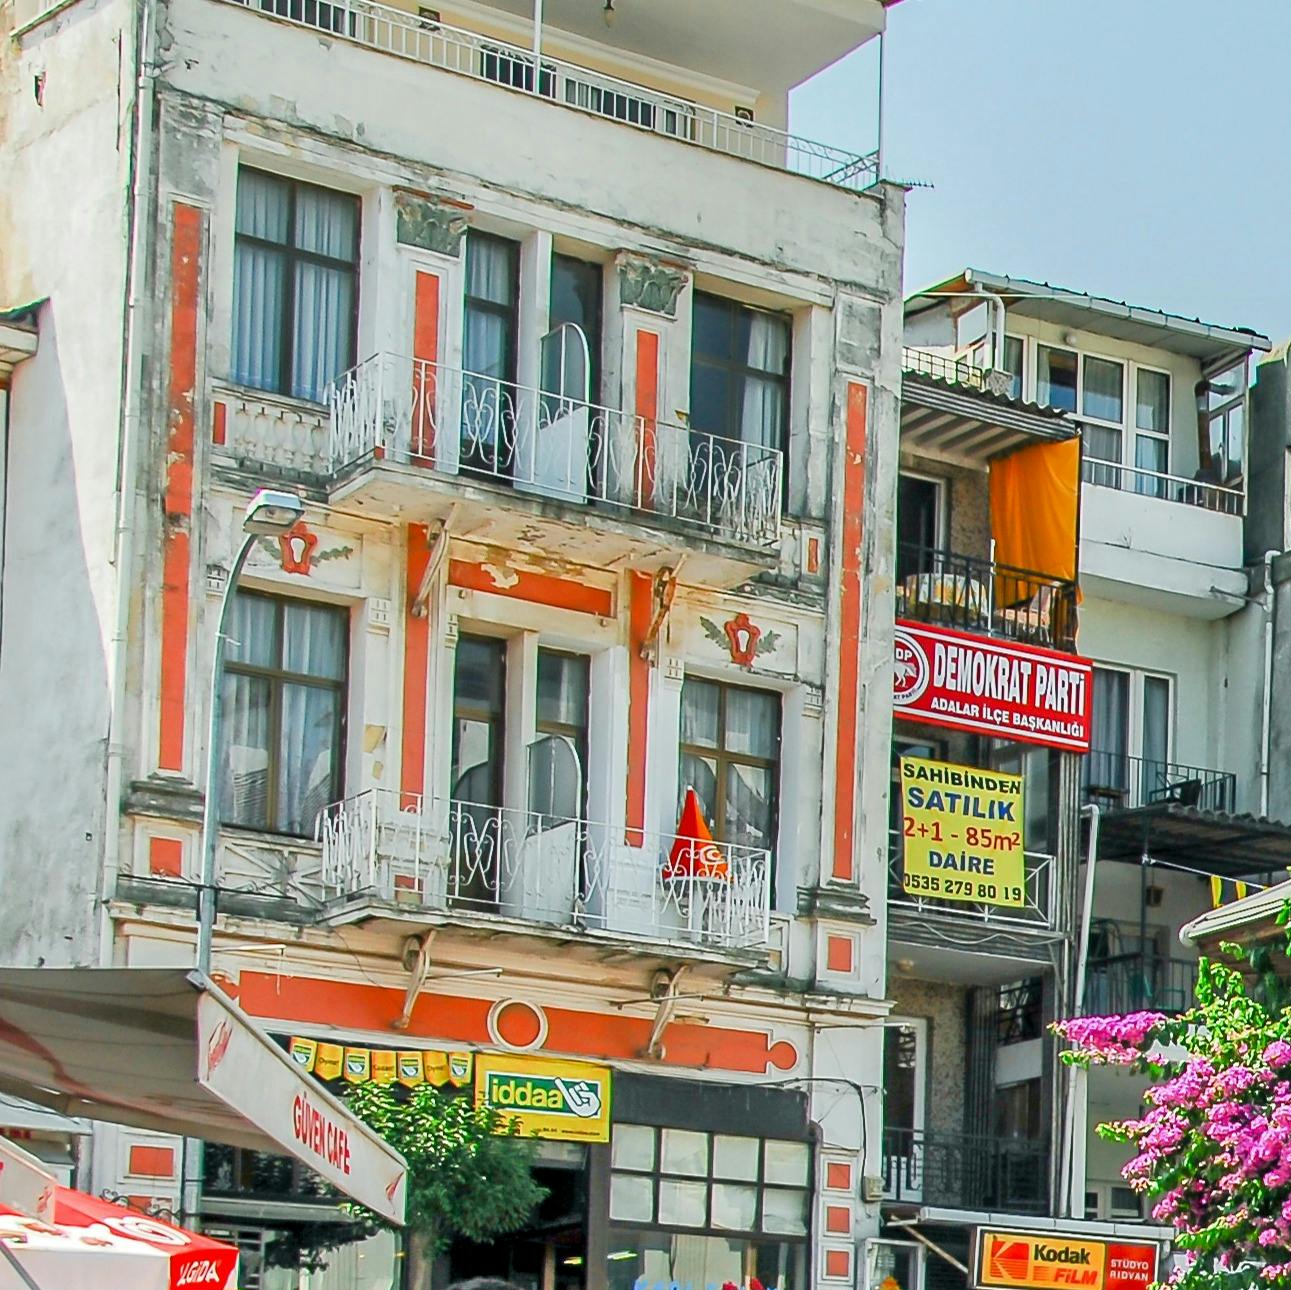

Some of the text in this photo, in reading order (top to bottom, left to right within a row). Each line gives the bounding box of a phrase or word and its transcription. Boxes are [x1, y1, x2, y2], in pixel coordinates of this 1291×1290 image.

[933, 642, 1032, 705] DEMOKRAT
[931, 697, 1084, 738] ADALAR İLÇE BAŞKANLIĞI
[903, 763, 1021, 794] SAHİBİNDEN
[908, 786, 1015, 822] SATILIK
[904, 817, 943, 842] 2+1
[929, 850, 995, 875] DAİRE
[904, 873, 1021, 902] 0535 279 80 19
[491, 1079, 564, 1109] iddaa
[293, 1090, 350, 1176] GÜVEN CAFE
[1034, 1244, 1091, 1265] Kodak
[1110, 1257, 1149, 1270] STÜDYO
[1110, 1270, 1148, 1281] RIDVAN
